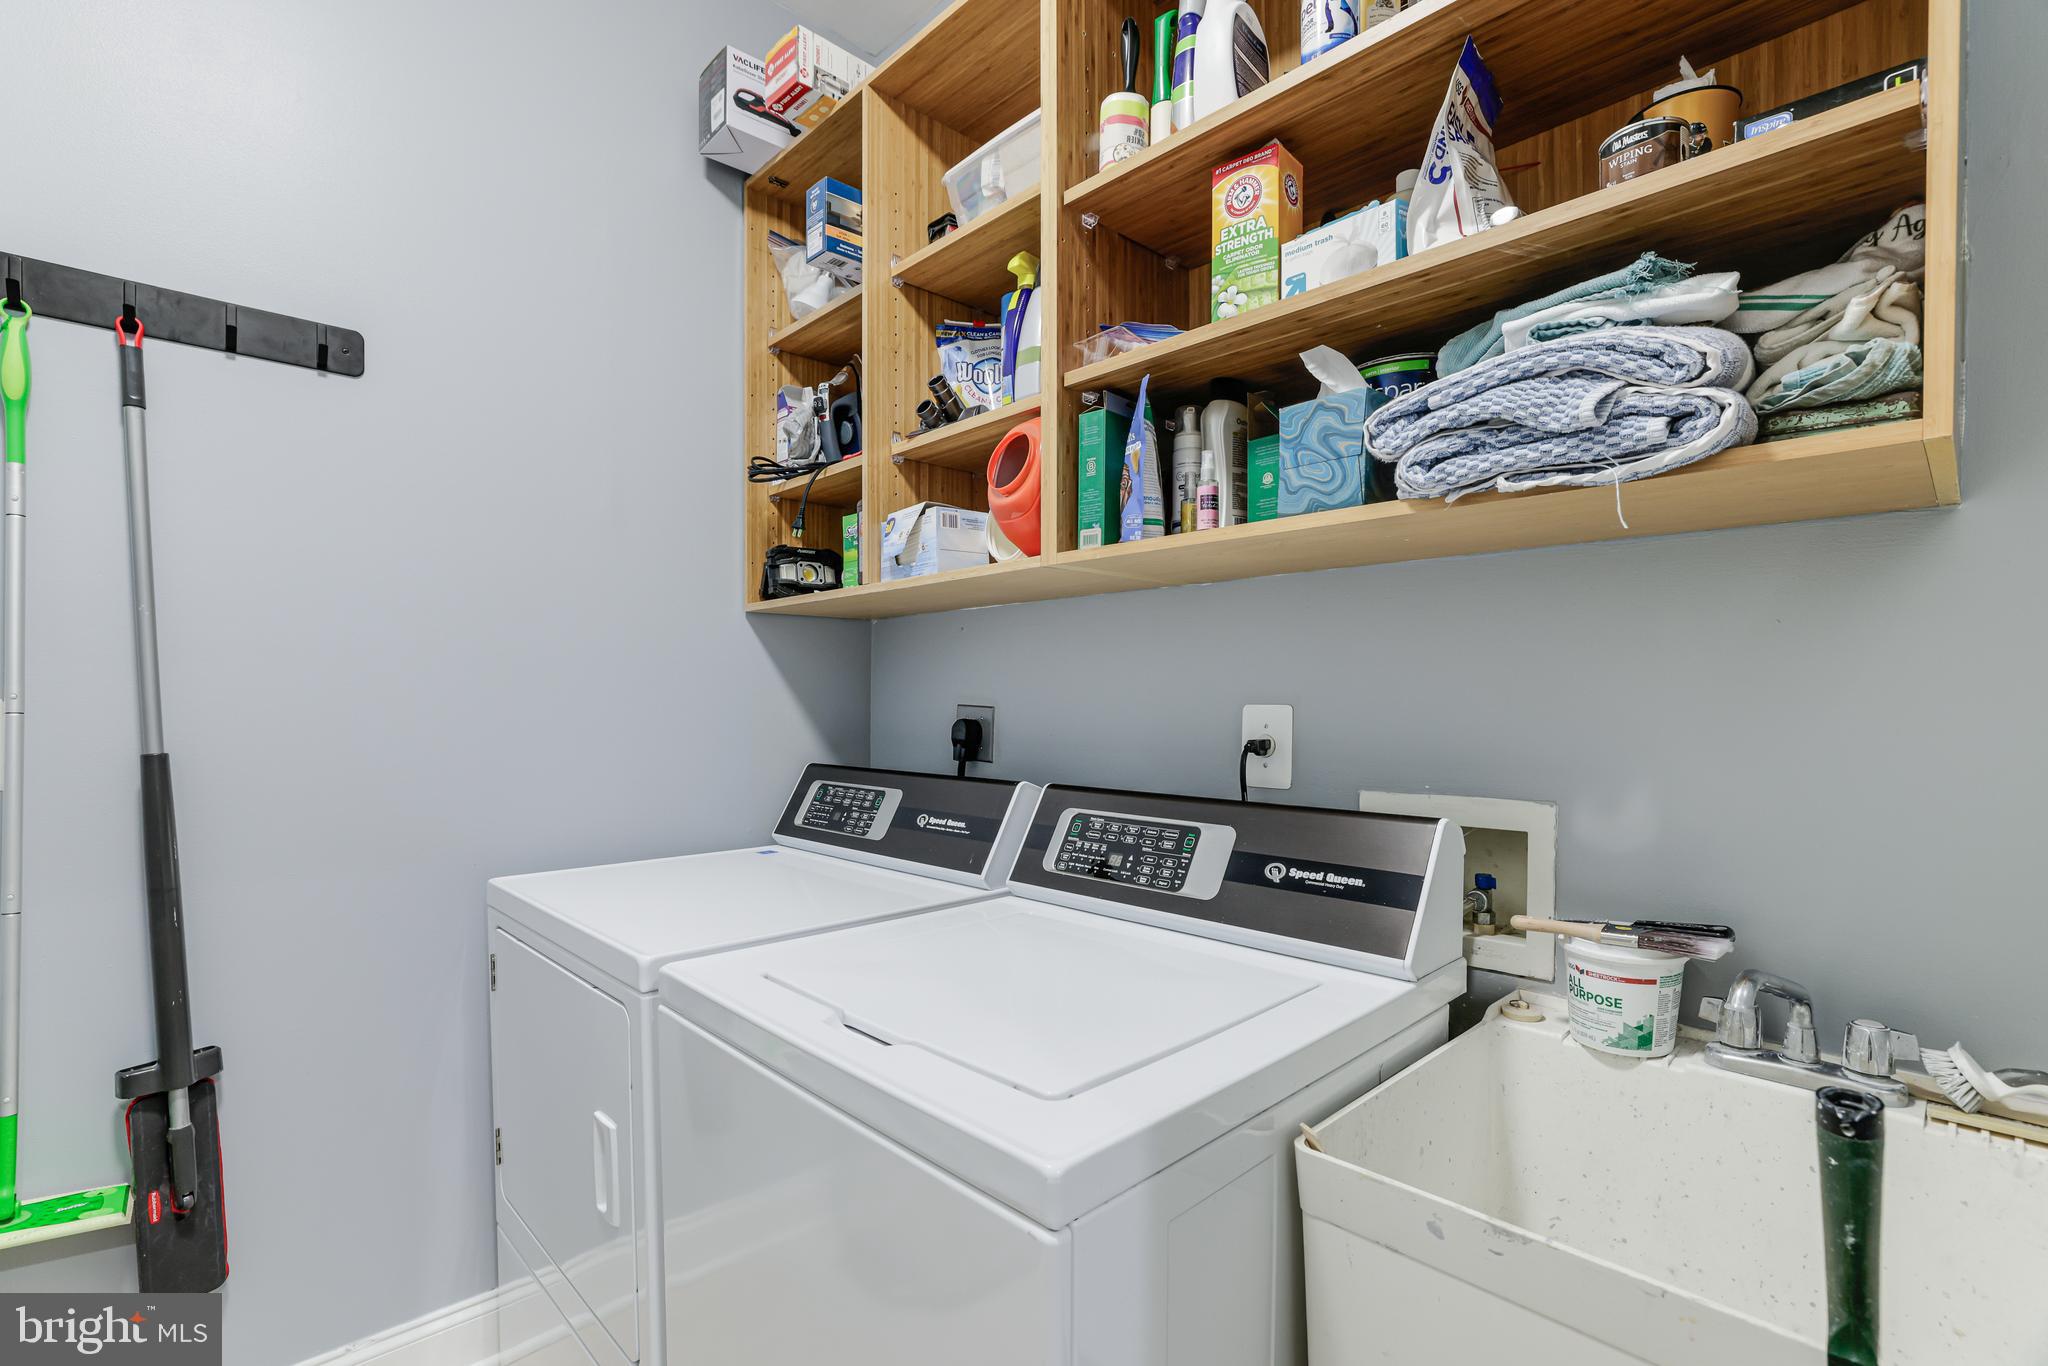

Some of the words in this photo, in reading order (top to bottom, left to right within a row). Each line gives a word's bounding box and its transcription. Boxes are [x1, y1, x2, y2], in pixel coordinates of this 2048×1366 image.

[1622, 130, 1649, 149] Masters
[1221, 159, 1243, 172] CARPET
[1608, 144, 1653, 169] WIPING
[1220, 216, 1267, 242] EXTRA
[1215, 228, 1274, 256] STRENGTH
[1314, 234, 1334, 246] trash
[928, 816, 947, 827] Speed
[1288, 867, 1324, 880] Speed
[1568, 973, 1584, 990] ALL
[1568, 985, 1623, 1010] PURPOSE
